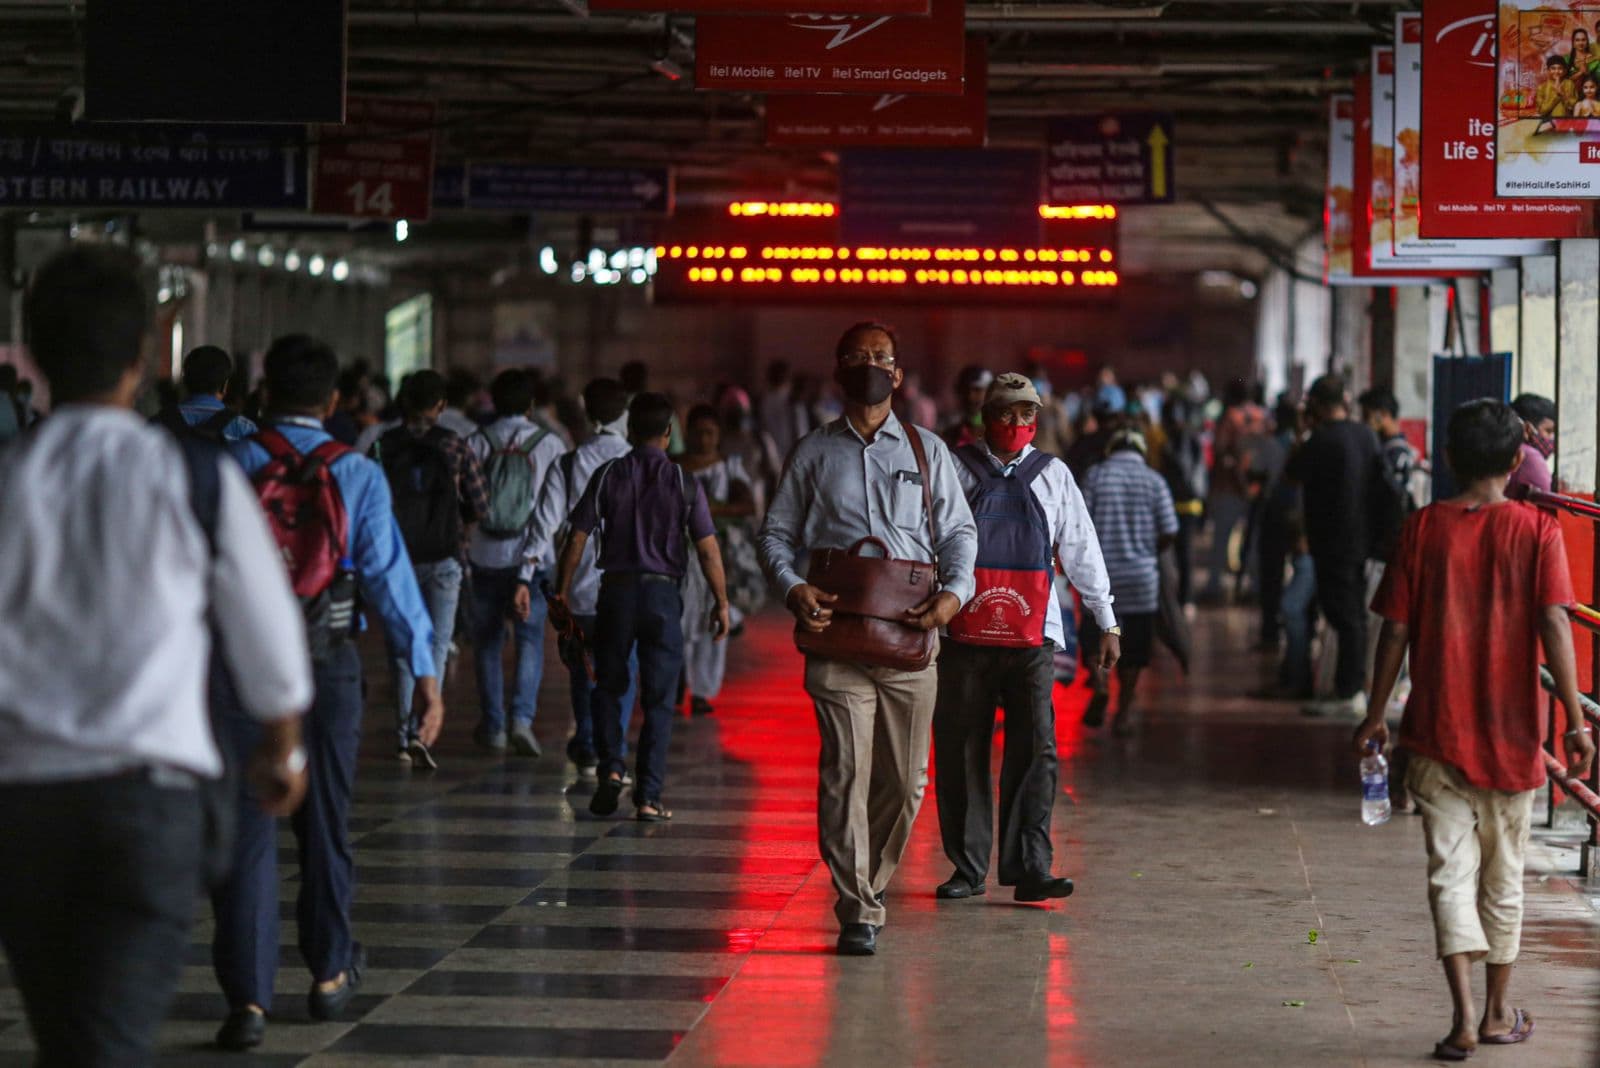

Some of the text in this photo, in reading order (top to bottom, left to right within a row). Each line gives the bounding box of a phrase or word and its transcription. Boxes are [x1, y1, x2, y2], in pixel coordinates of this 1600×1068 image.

[710, 65, 775, 78] itel Mobile
[784, 66, 821, 79] itel TV
[832, 67, 948, 83] itel Smart Gadgets
[1443, 141, 1479, 160] Life
[99, 178, 229, 200] RAILWAY
[347, 181, 394, 216] 14
[1451, 203, 1478, 212] Mobile
[1496, 204, 1506, 212] TV
[1525, 204, 1547, 212] Smart
[1547, 204, 1582, 214] Gadgets
